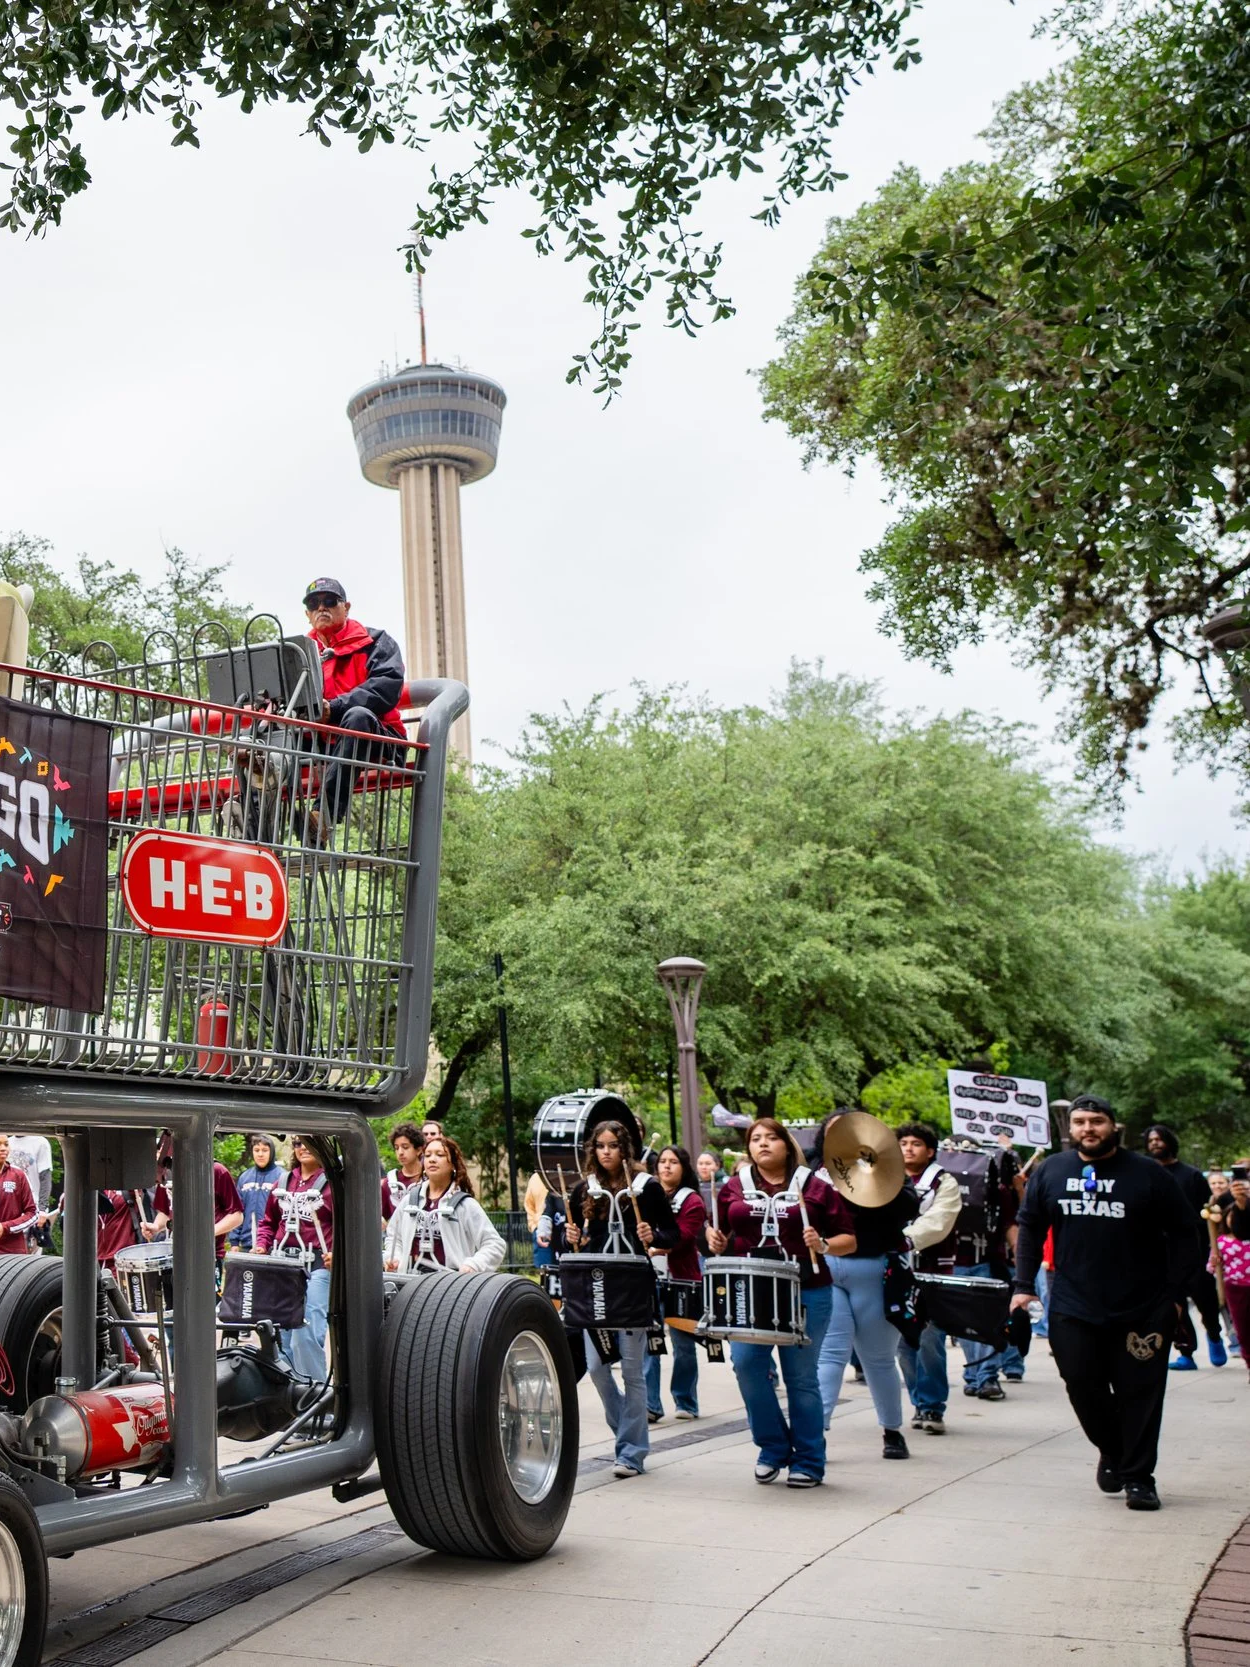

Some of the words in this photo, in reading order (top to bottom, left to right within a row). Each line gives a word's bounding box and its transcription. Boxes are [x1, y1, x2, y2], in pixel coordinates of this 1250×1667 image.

[955, 1085, 1008, 1103] HIGHLANDS
[976, 1076, 1017, 1091] SUPPORT
[955, 1108, 976, 1120] HELP
[1057, 1198, 1126, 1219] TEXAS
[132, 1284, 143, 1311] YAMAHA
[242, 1282, 253, 1319] YAMAHA
[592, 1280, 607, 1321] YAMAHA
[735, 1290, 747, 1325] YAMAHA
[152, 1425, 169, 1435] COLA
